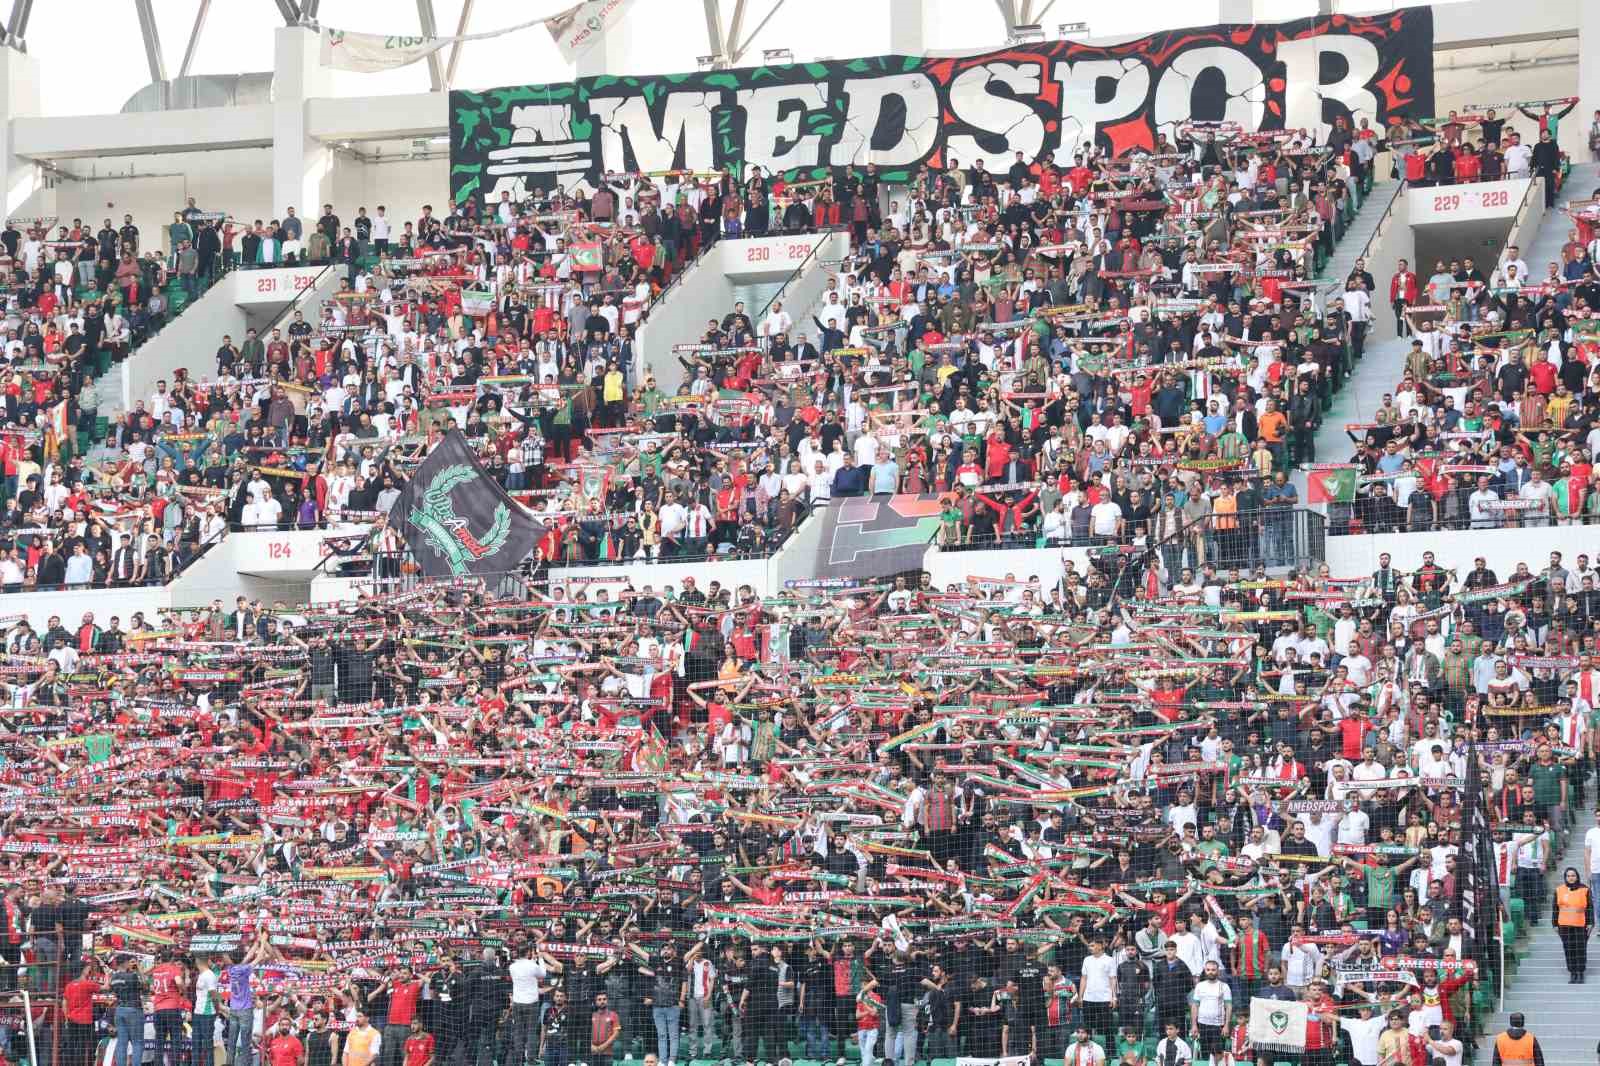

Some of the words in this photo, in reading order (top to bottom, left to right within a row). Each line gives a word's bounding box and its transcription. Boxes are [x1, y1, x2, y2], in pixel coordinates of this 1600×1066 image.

[481, 34, 1378, 204] AMEDSPOR
[1434, 195, 1460, 211] 229
[1482, 191, 1508, 207] 228
[748, 246, 769, 261] 230
[788, 244, 811, 259] 229
[258, 278, 276, 292] 231
[269, 543, 291, 558] 124
[319, 544, 333, 556] 12
[1287, 802, 1338, 811] AMEDSPOR
[549, 943, 614, 955] ULTRAMED
[153, 978, 168, 994] 21
